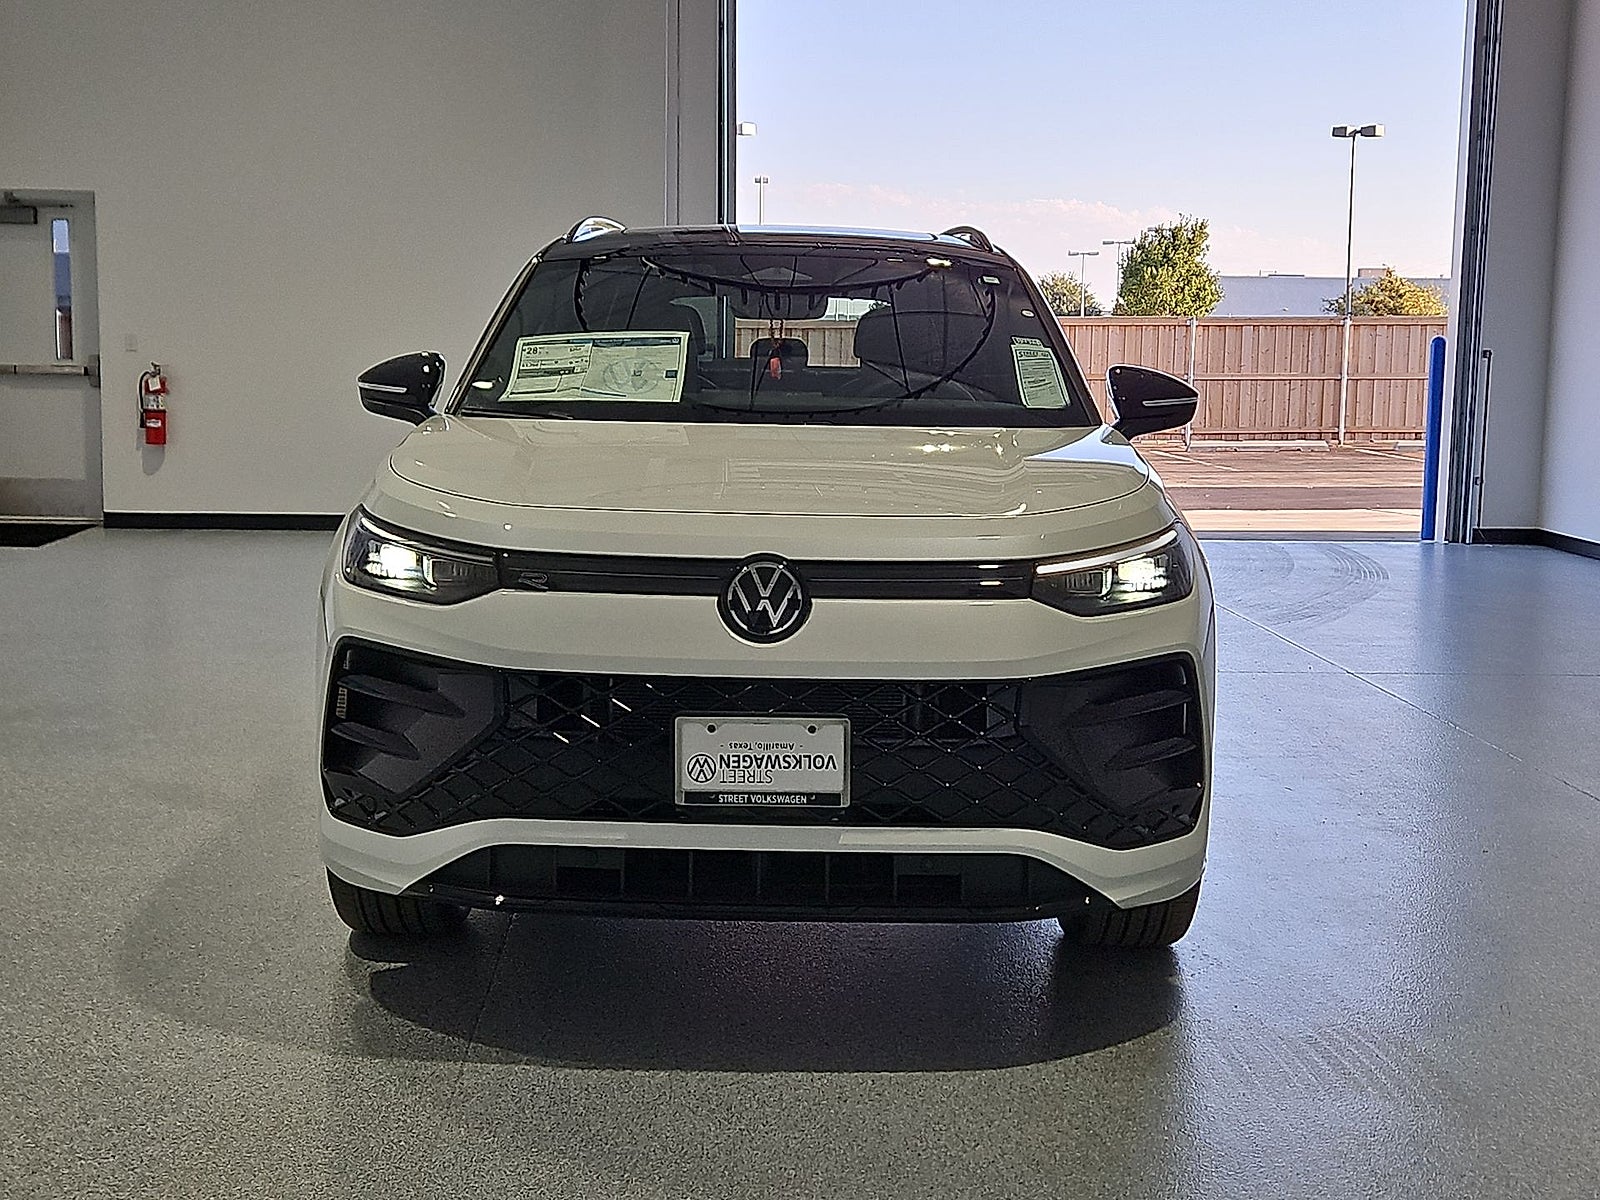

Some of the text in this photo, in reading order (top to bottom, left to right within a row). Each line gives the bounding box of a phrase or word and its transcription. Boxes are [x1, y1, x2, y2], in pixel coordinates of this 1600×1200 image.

[728, 741, 795, 751] Amarillo, Texas
[719, 753, 837, 770] VOLKSWAGEN
[719, 769, 773, 784] STREET
[718, 794, 807, 804] STREET VOLKSWAGEN
